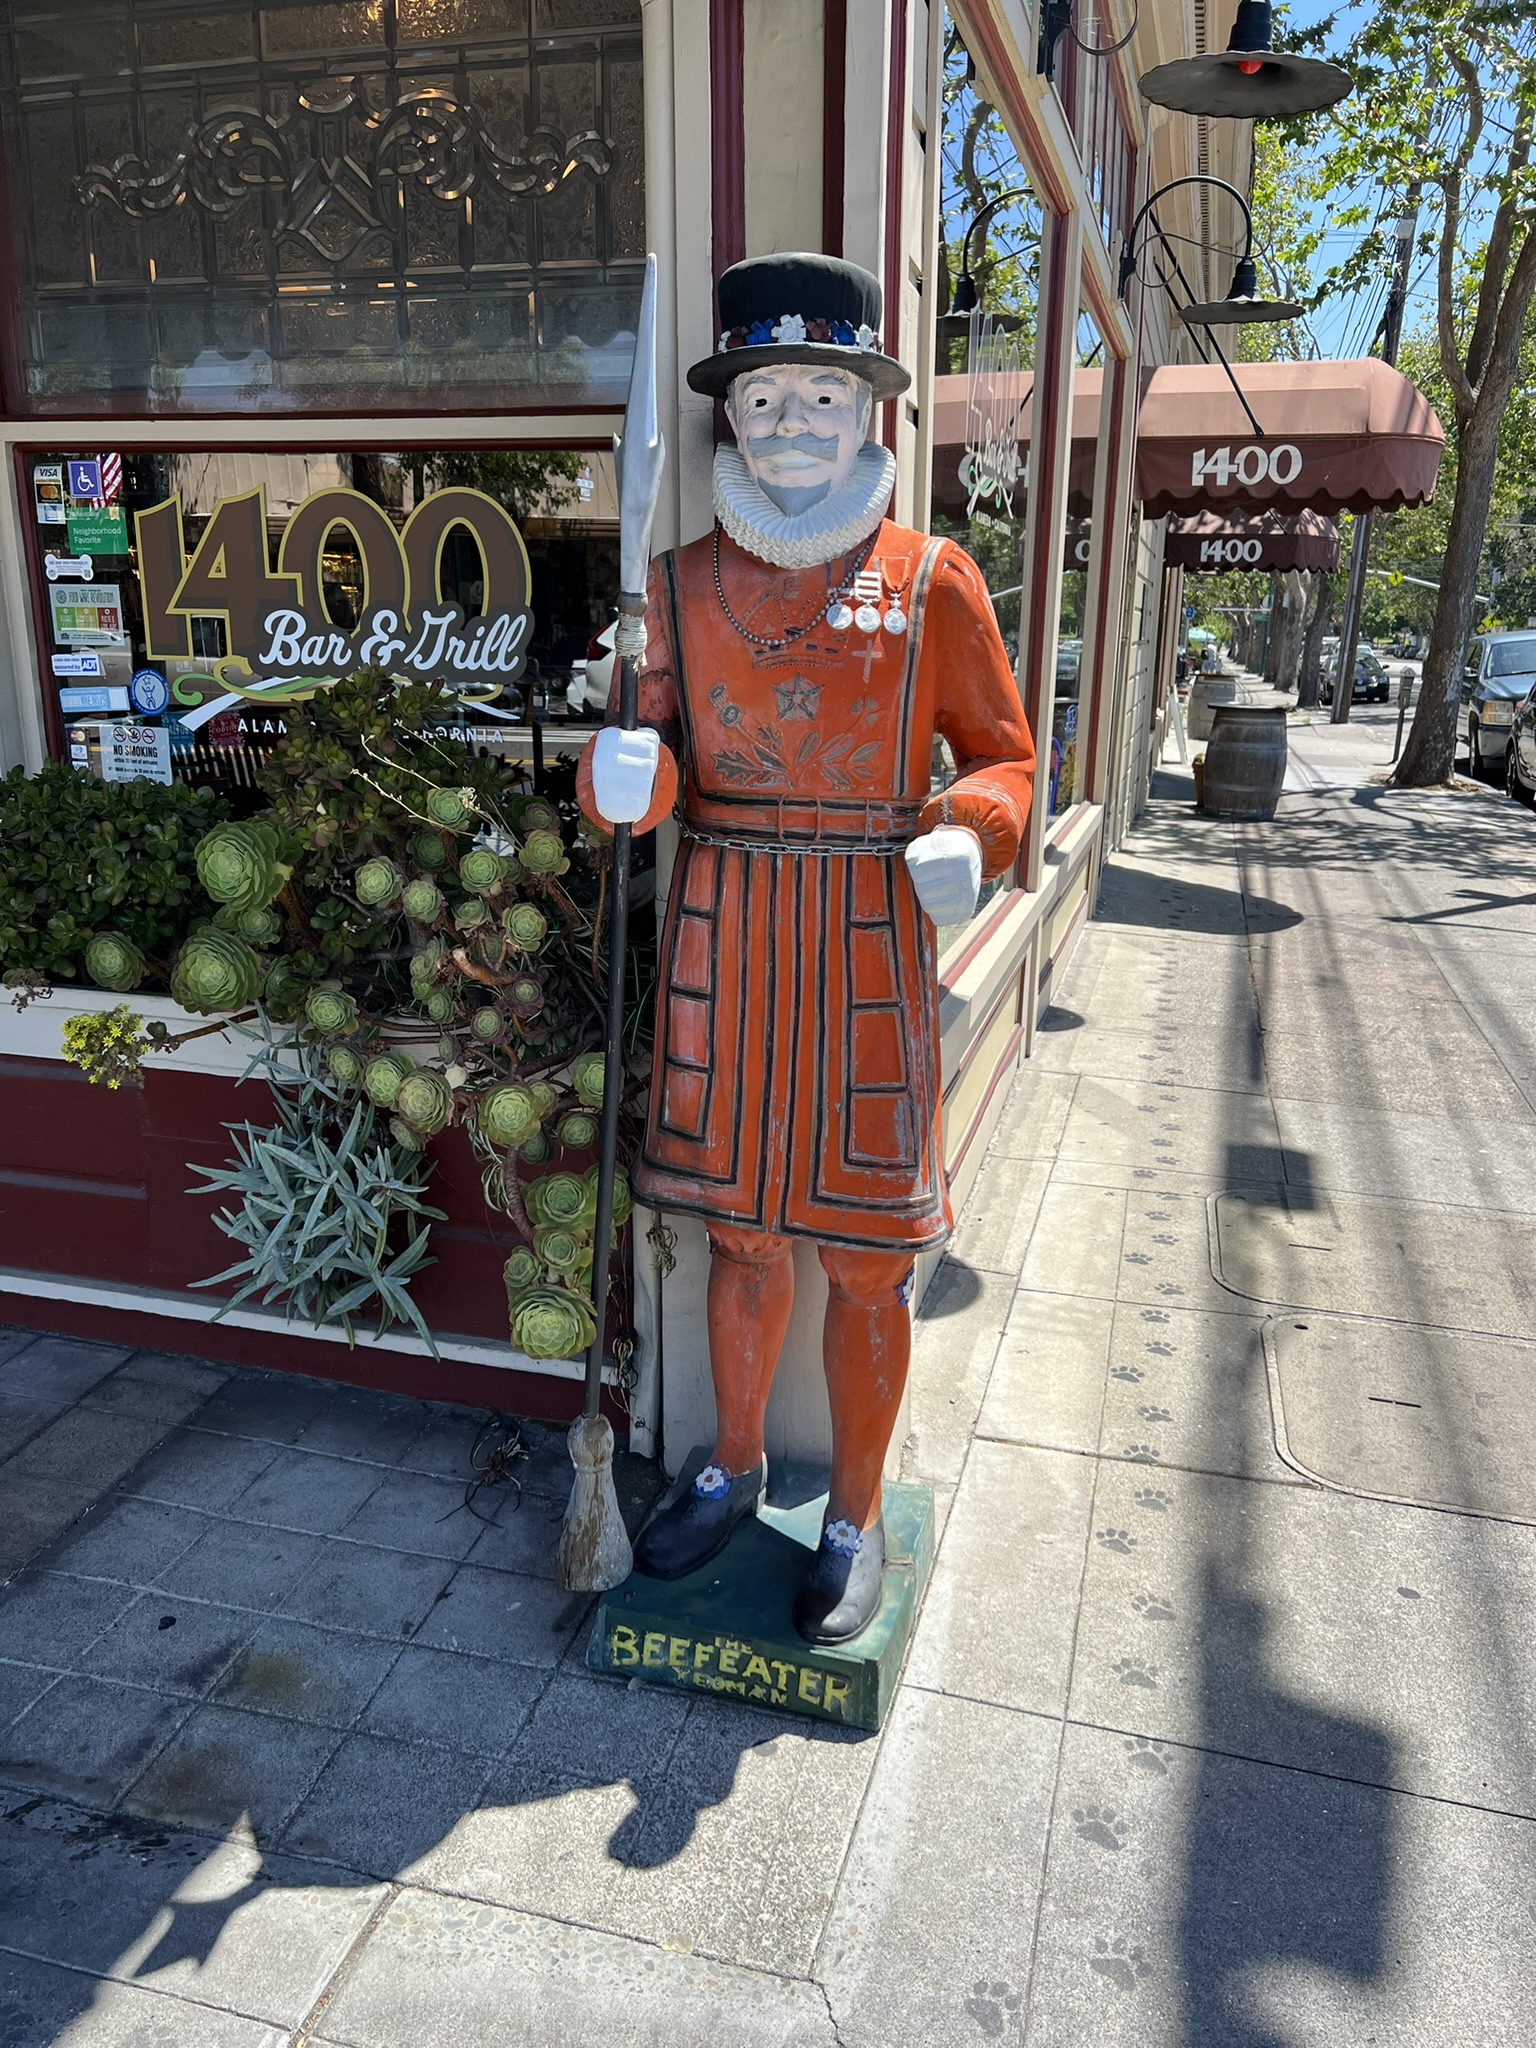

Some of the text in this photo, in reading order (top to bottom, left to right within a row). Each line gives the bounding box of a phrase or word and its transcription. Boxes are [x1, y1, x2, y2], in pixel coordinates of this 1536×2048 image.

[39, 468, 59, 477] VISA
[1191, 444, 1303, 487] 1400
[73, 527, 122, 536] Neighborhood
[74, 536, 102, 544] Favorite
[1200, 539, 1263, 563] 1400
[133, 482, 532, 662] 1400
[258, 609, 528, 672] Bar & Grill
[82, 659, 98, 671] ADT
[113, 744, 158, 758] NO SMOKING
[611, 1624, 851, 1717] BEEFEATER
[672, 1666, 788, 1706] YEOMAN
